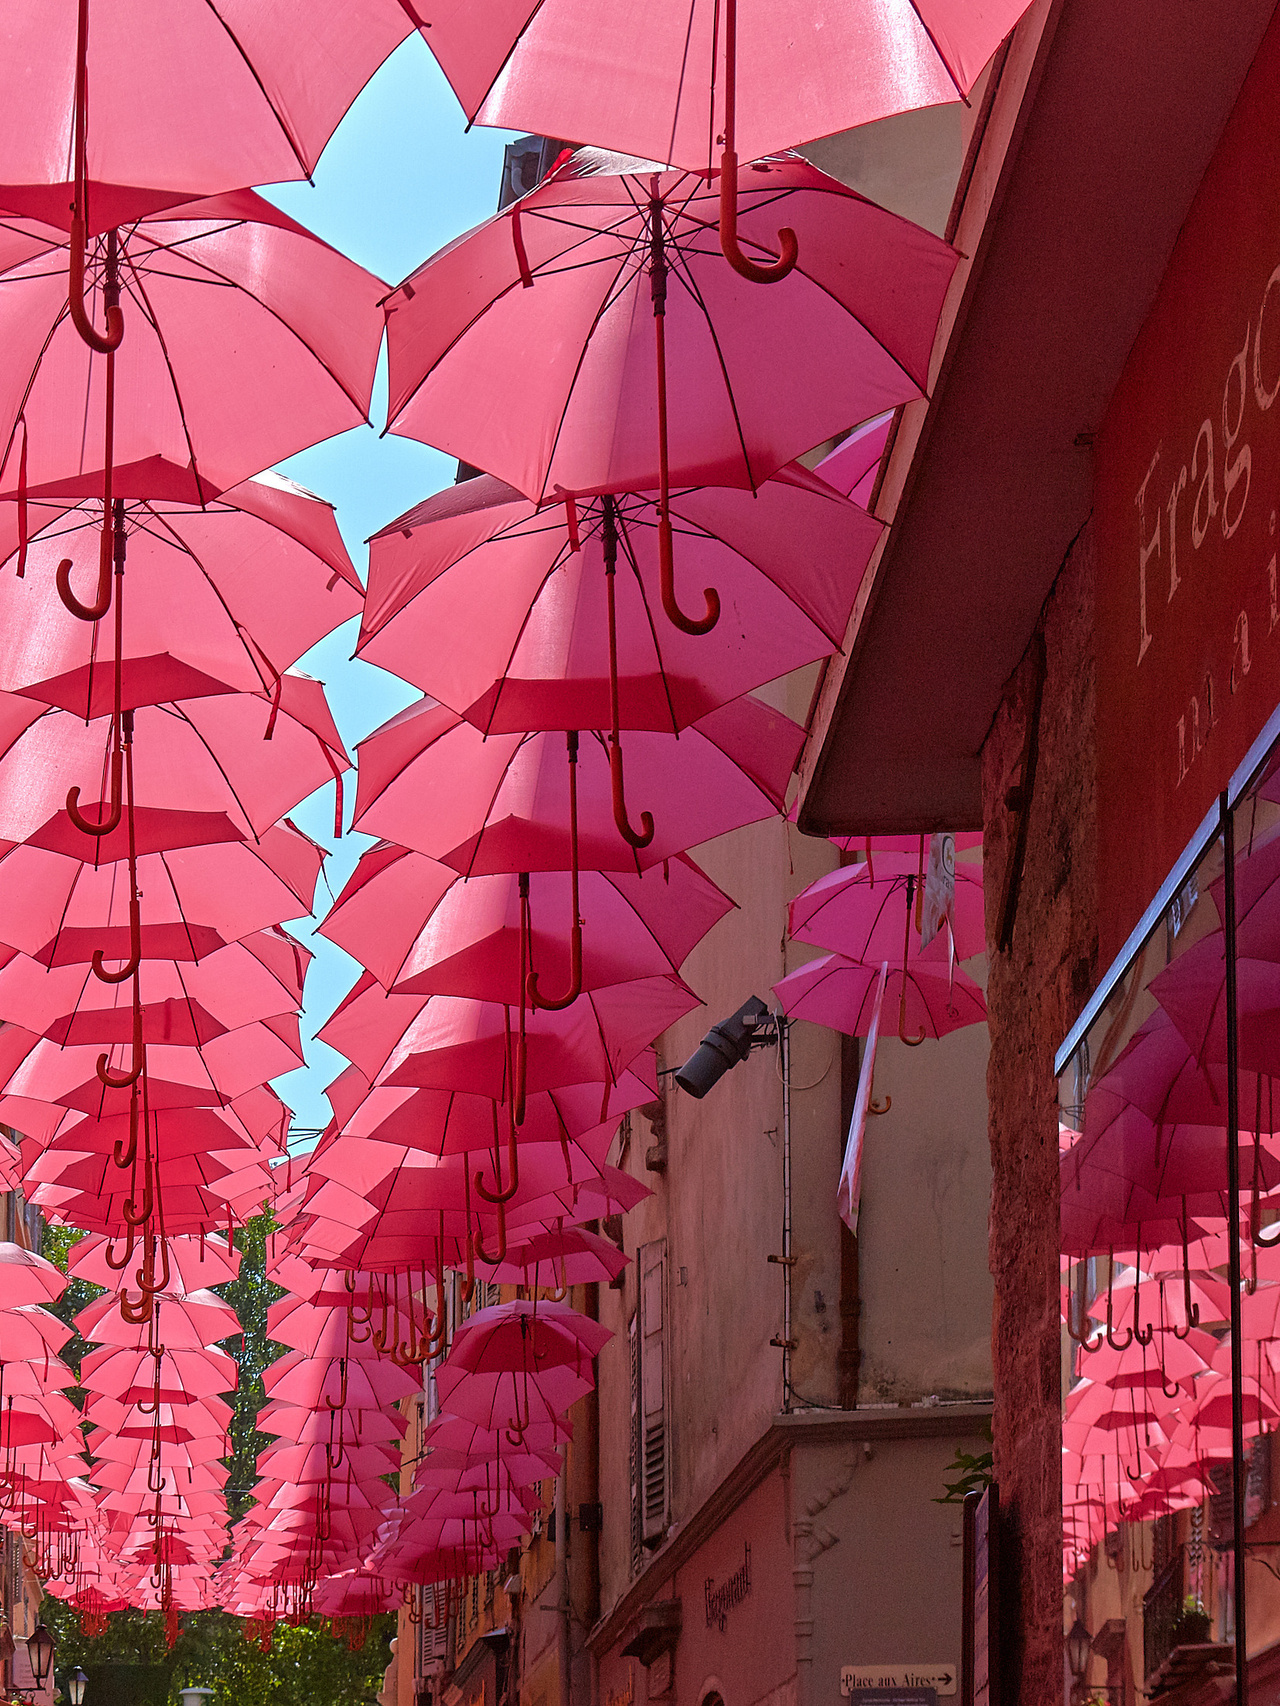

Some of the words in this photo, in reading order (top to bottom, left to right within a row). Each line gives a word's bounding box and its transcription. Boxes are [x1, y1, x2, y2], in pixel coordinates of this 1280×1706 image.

[845, 1674, 874, 1687] Place
[878, 1677, 897, 1687] aux
[902, 1673, 932, 1687] Aires
